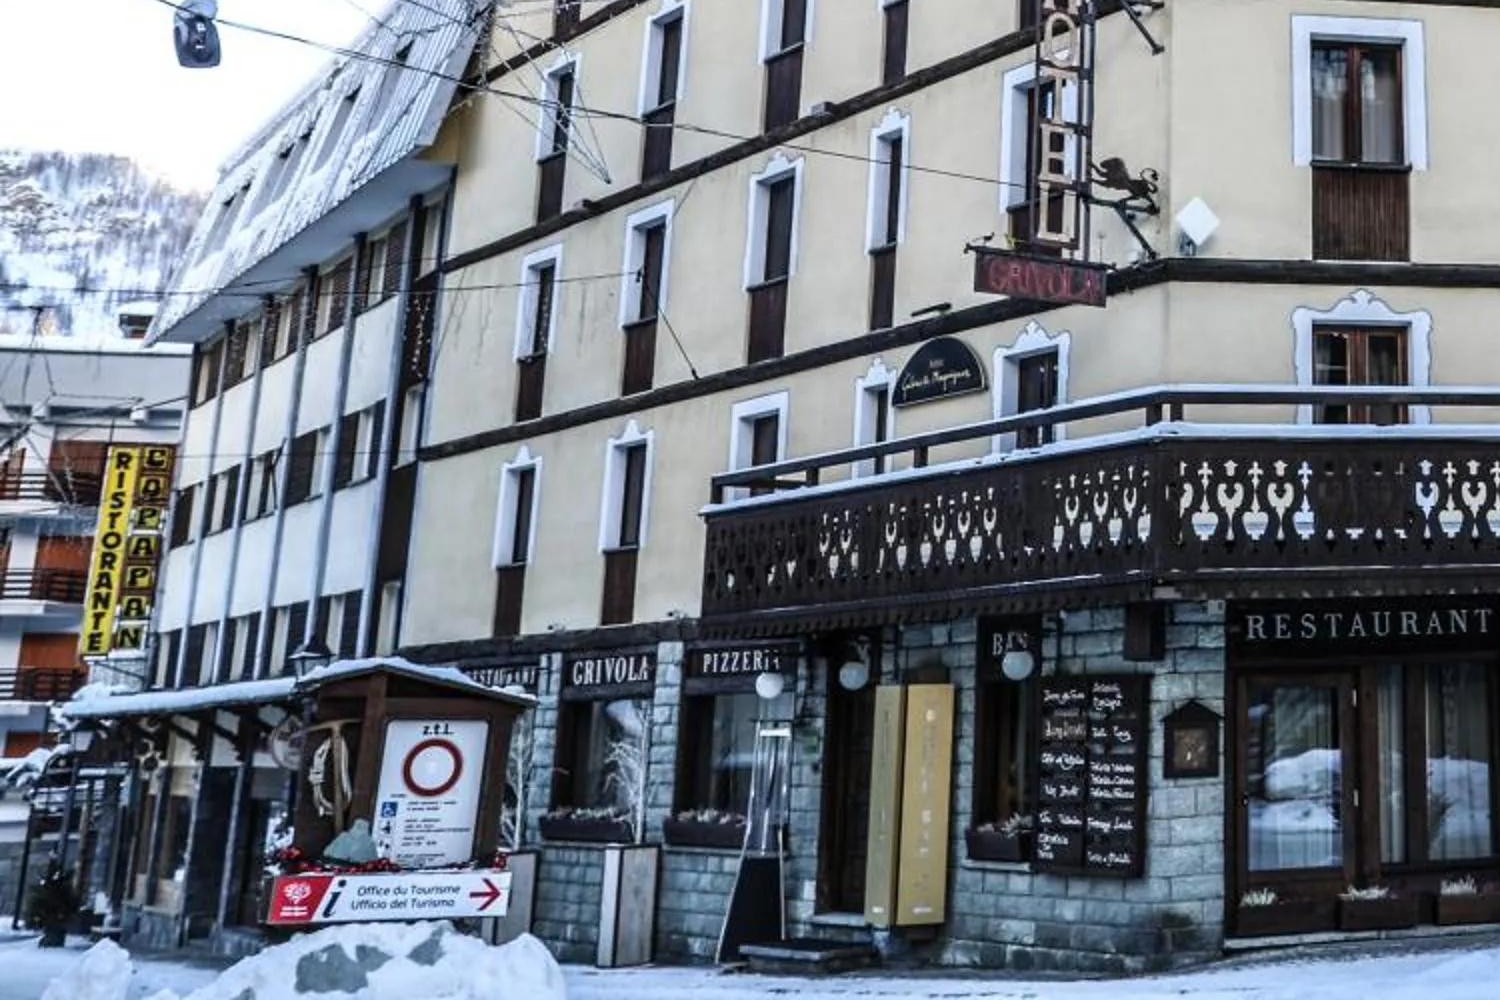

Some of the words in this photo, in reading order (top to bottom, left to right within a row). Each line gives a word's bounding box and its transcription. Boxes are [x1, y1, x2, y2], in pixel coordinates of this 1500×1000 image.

[87, 451, 132, 651] RISTORANTE
[1245, 608, 1492, 640] RESTAURANT
[572, 656, 648, 686] GRIVOLA
[351, 899, 387, 911] Ufficio
[389, 899, 408, 909] del
[411, 898, 455, 909] Turismo
[357, 885, 391, 897] Office
[393, 885, 408, 895] du
[411, 885, 460, 895] Tourisme
